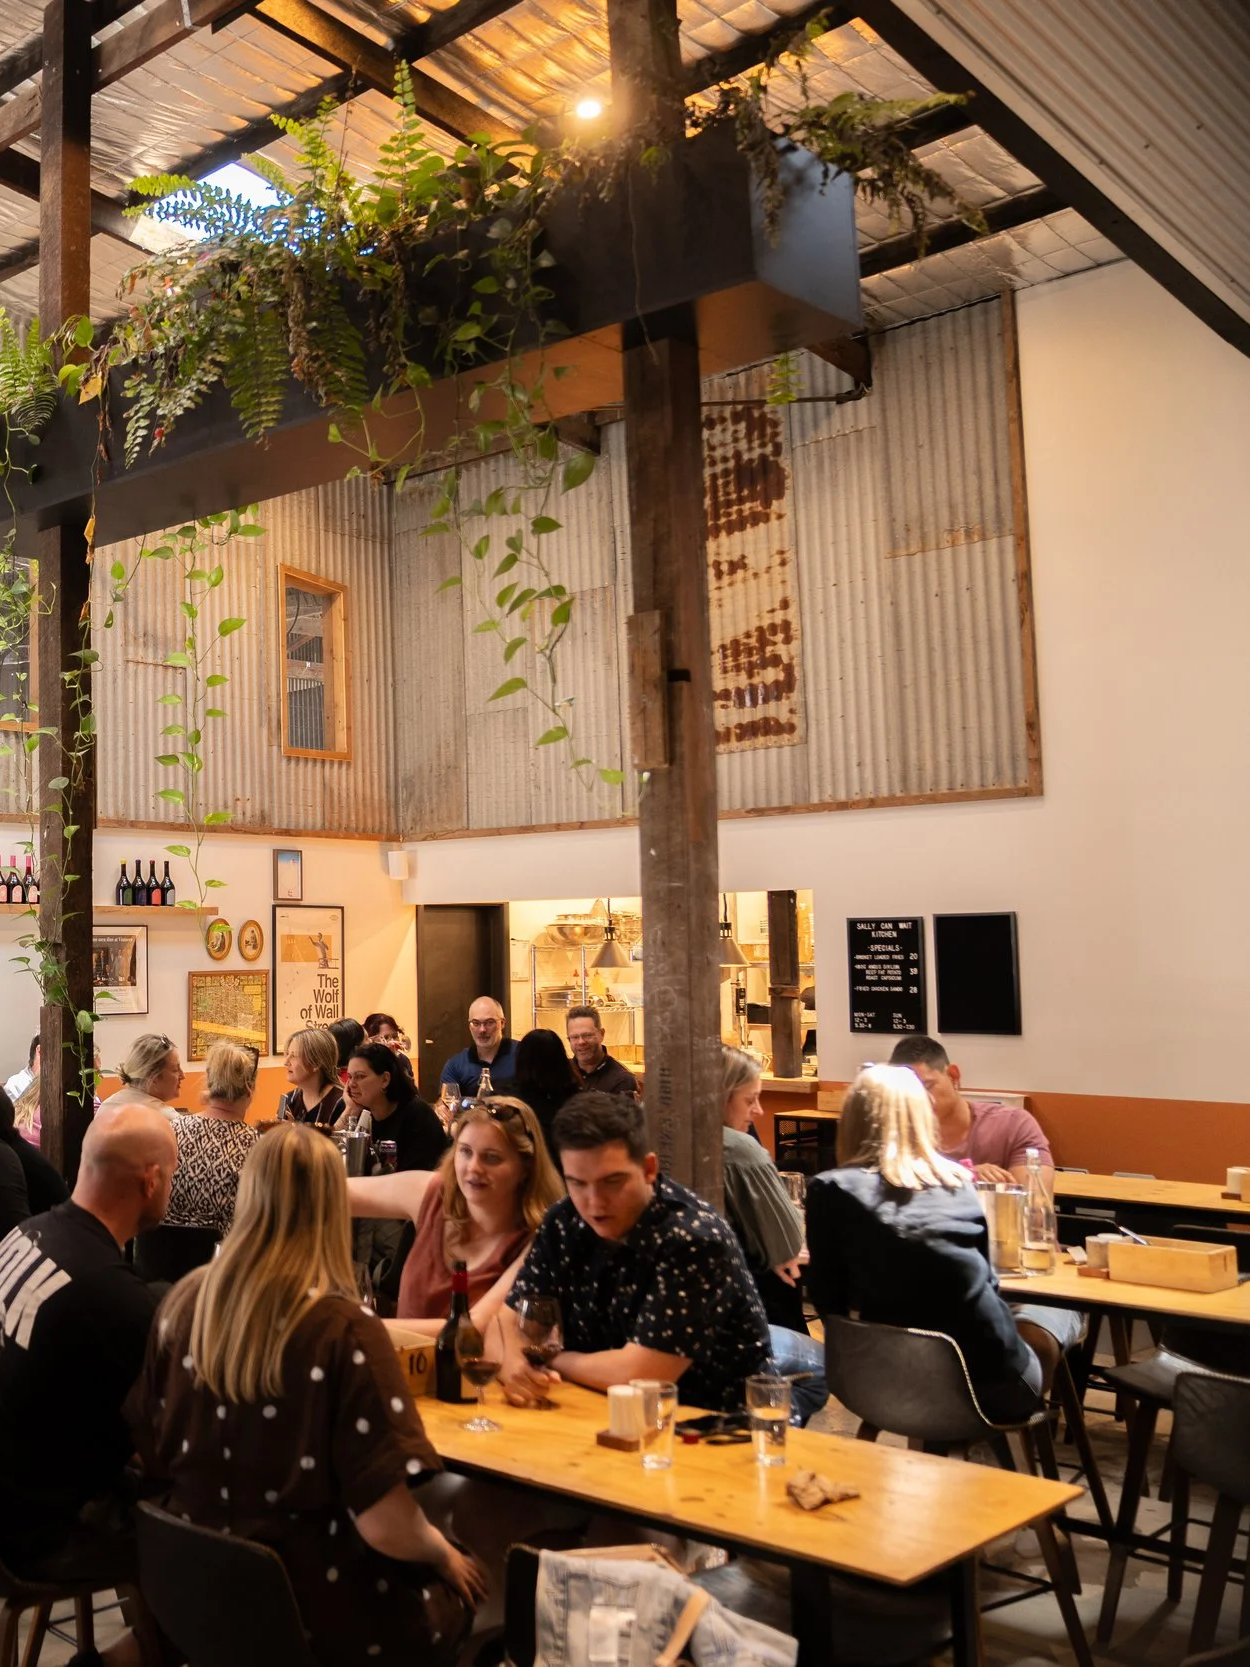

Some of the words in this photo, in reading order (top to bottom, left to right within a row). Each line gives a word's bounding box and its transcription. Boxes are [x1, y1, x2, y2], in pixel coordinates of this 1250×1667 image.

[856, 922, 876, 930] SALLY
[880, 922, 893, 930] CAN
[317, 974, 339, 988] The
[313, 989, 339, 1003] Wolf
[300, 1005, 312, 1019] of
[315, 1004, 339, 1018] Wall
[306, 1020, 329, 1030] Stre
[409, 1351, 428, 1375] 10
